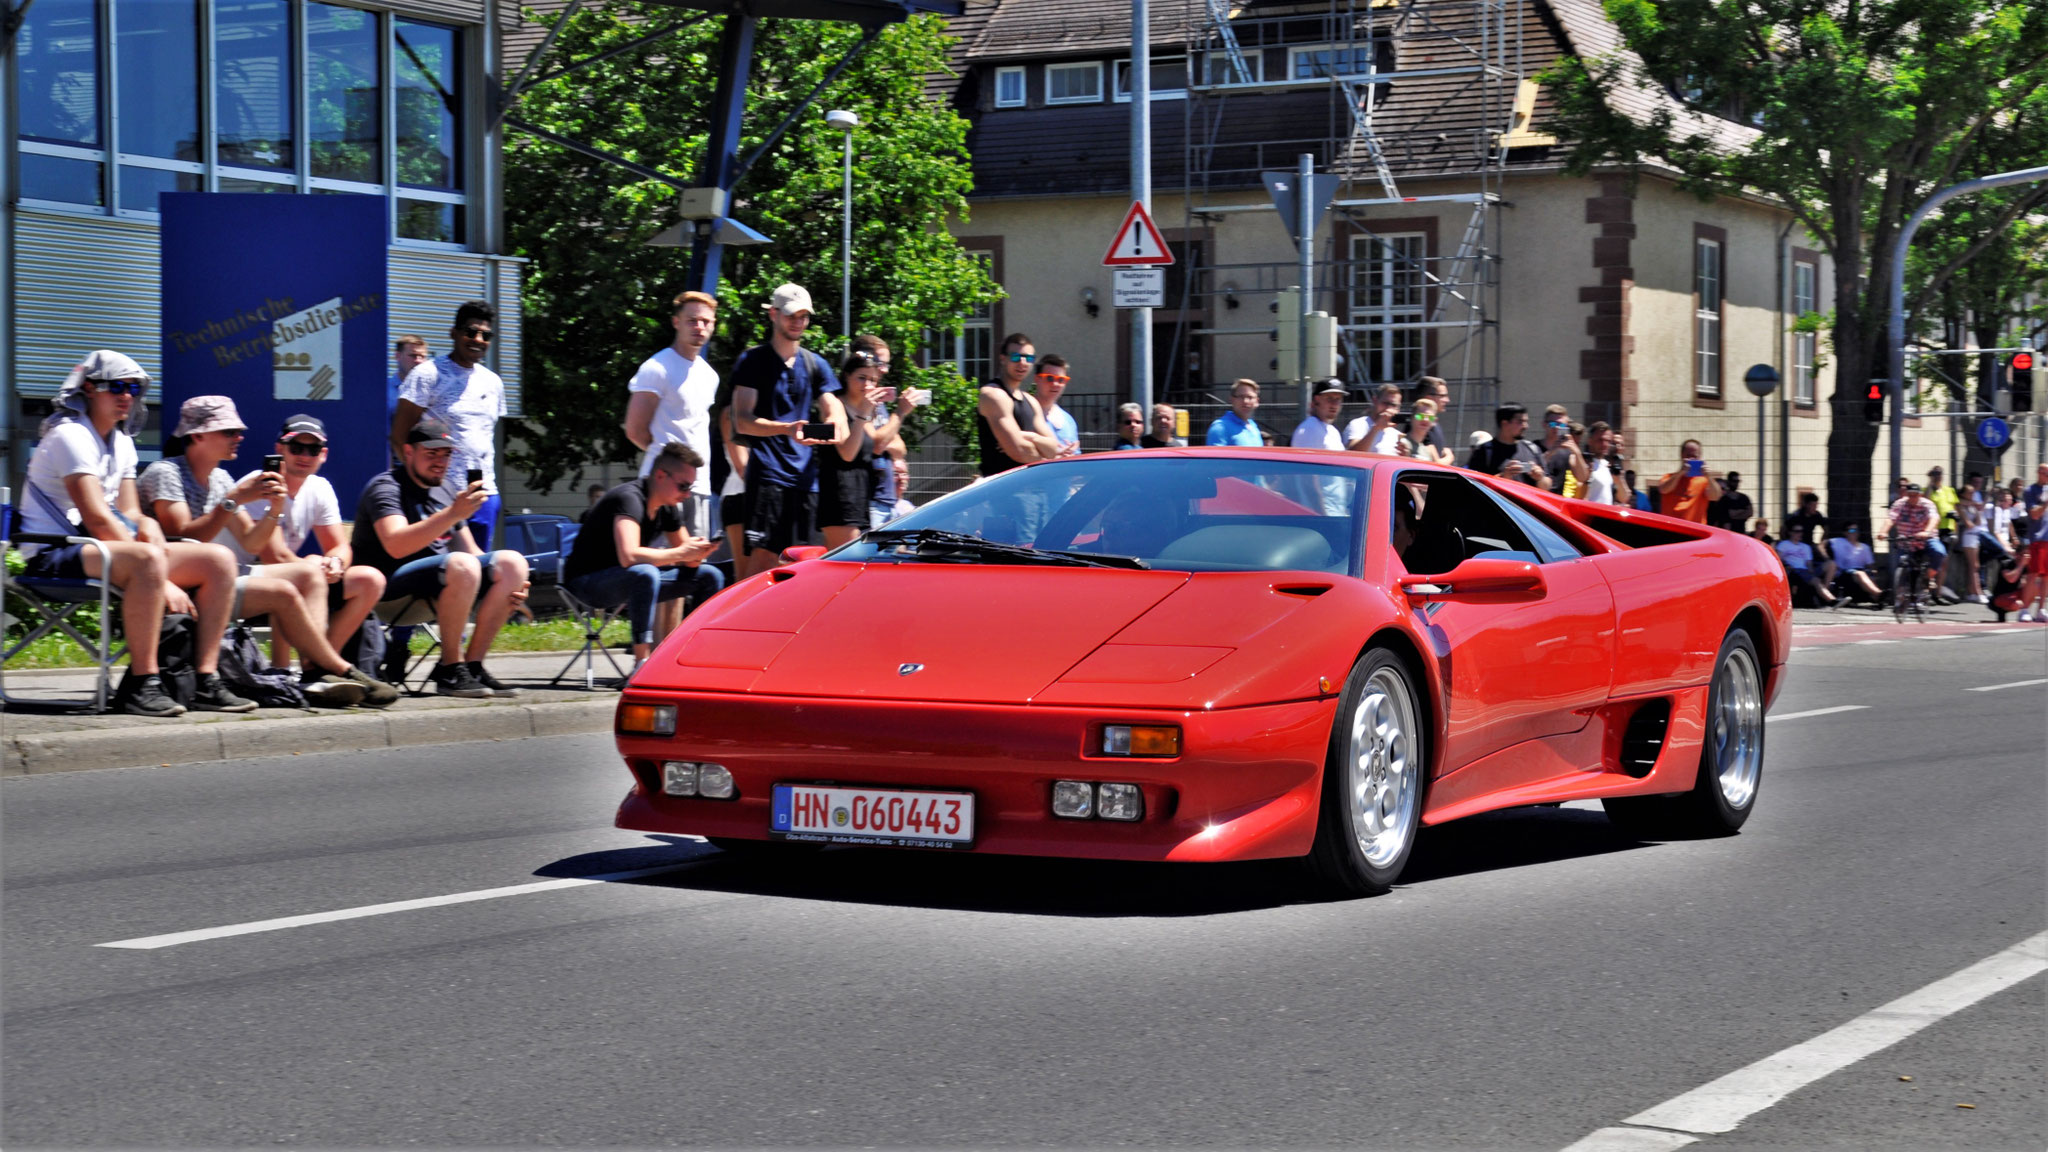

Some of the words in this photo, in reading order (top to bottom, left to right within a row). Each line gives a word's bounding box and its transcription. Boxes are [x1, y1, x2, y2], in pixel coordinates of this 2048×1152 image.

[169, 296, 295, 353] Technische
[212, 293, 381, 368] Betriebsdienste
[779, 813, 788, 824] D
[793, 792, 830, 828] HN
[852, 795, 962, 835] 060443
